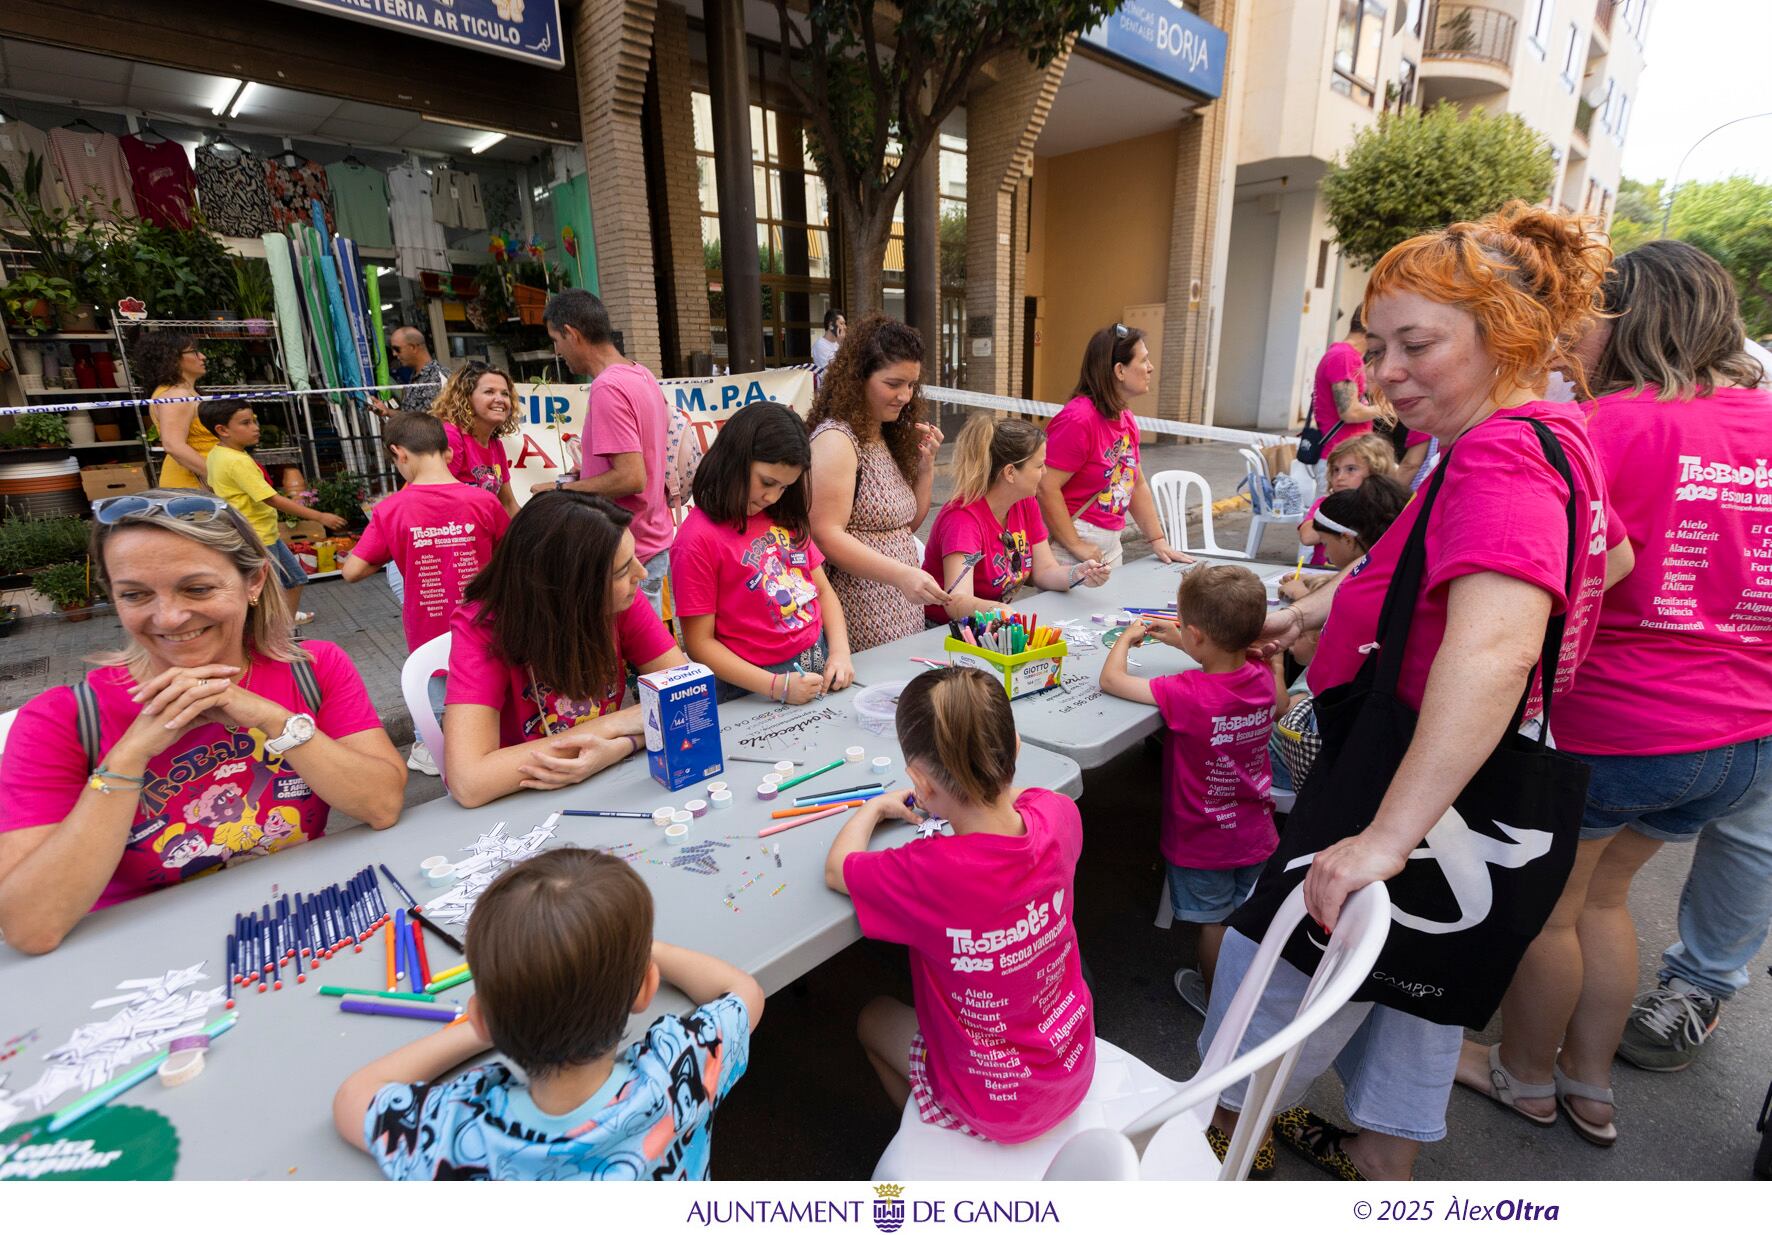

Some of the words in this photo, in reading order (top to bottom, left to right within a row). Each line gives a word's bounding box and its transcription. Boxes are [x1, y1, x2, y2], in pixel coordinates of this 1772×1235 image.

[1157, 16, 1208, 73] BORJA
[1675, 483, 1718, 501] 2025
[1679, 519, 1708, 530] Aielo
[1665, 529, 1675, 539] de
[1676, 529, 1721, 542] Malferit
[1669, 543, 1708, 554] Alacant
[1662, 557, 1710, 569] Albuixech
[1664, 571, 1697, 583] Algímia
[1662, 582, 1694, 592] d'Alfara
[1653, 596, 1698, 609] Benifaraig
[1657, 606, 1694, 617] València
[1640, 618, 1705, 631] Benimantell
[1023, 662, 1049, 675] GIOTTO
[670, 683, 707, 702] JUNIOR
[213, 761, 248, 782] 2025
[951, 956, 994, 974] 2025
[1372, 971, 1445, 997] CAMPOS
[951, 991, 963, 1003] de
[965, 997, 1009, 1009] Malferit
[964, 988, 994, 1000] Aielo
[960, 1007, 1001, 1022] Alacant
[1038, 990, 1077, 1034] Guardamar
[1048, 1003, 1087, 1048] L'Alguenya
[976, 1057, 1021, 1069] València
[1063, 1042, 1084, 1073] Xàtiva
[984, 1079, 1020, 1090] Bétera
[989, 1091, 1018, 1102] Betxí
